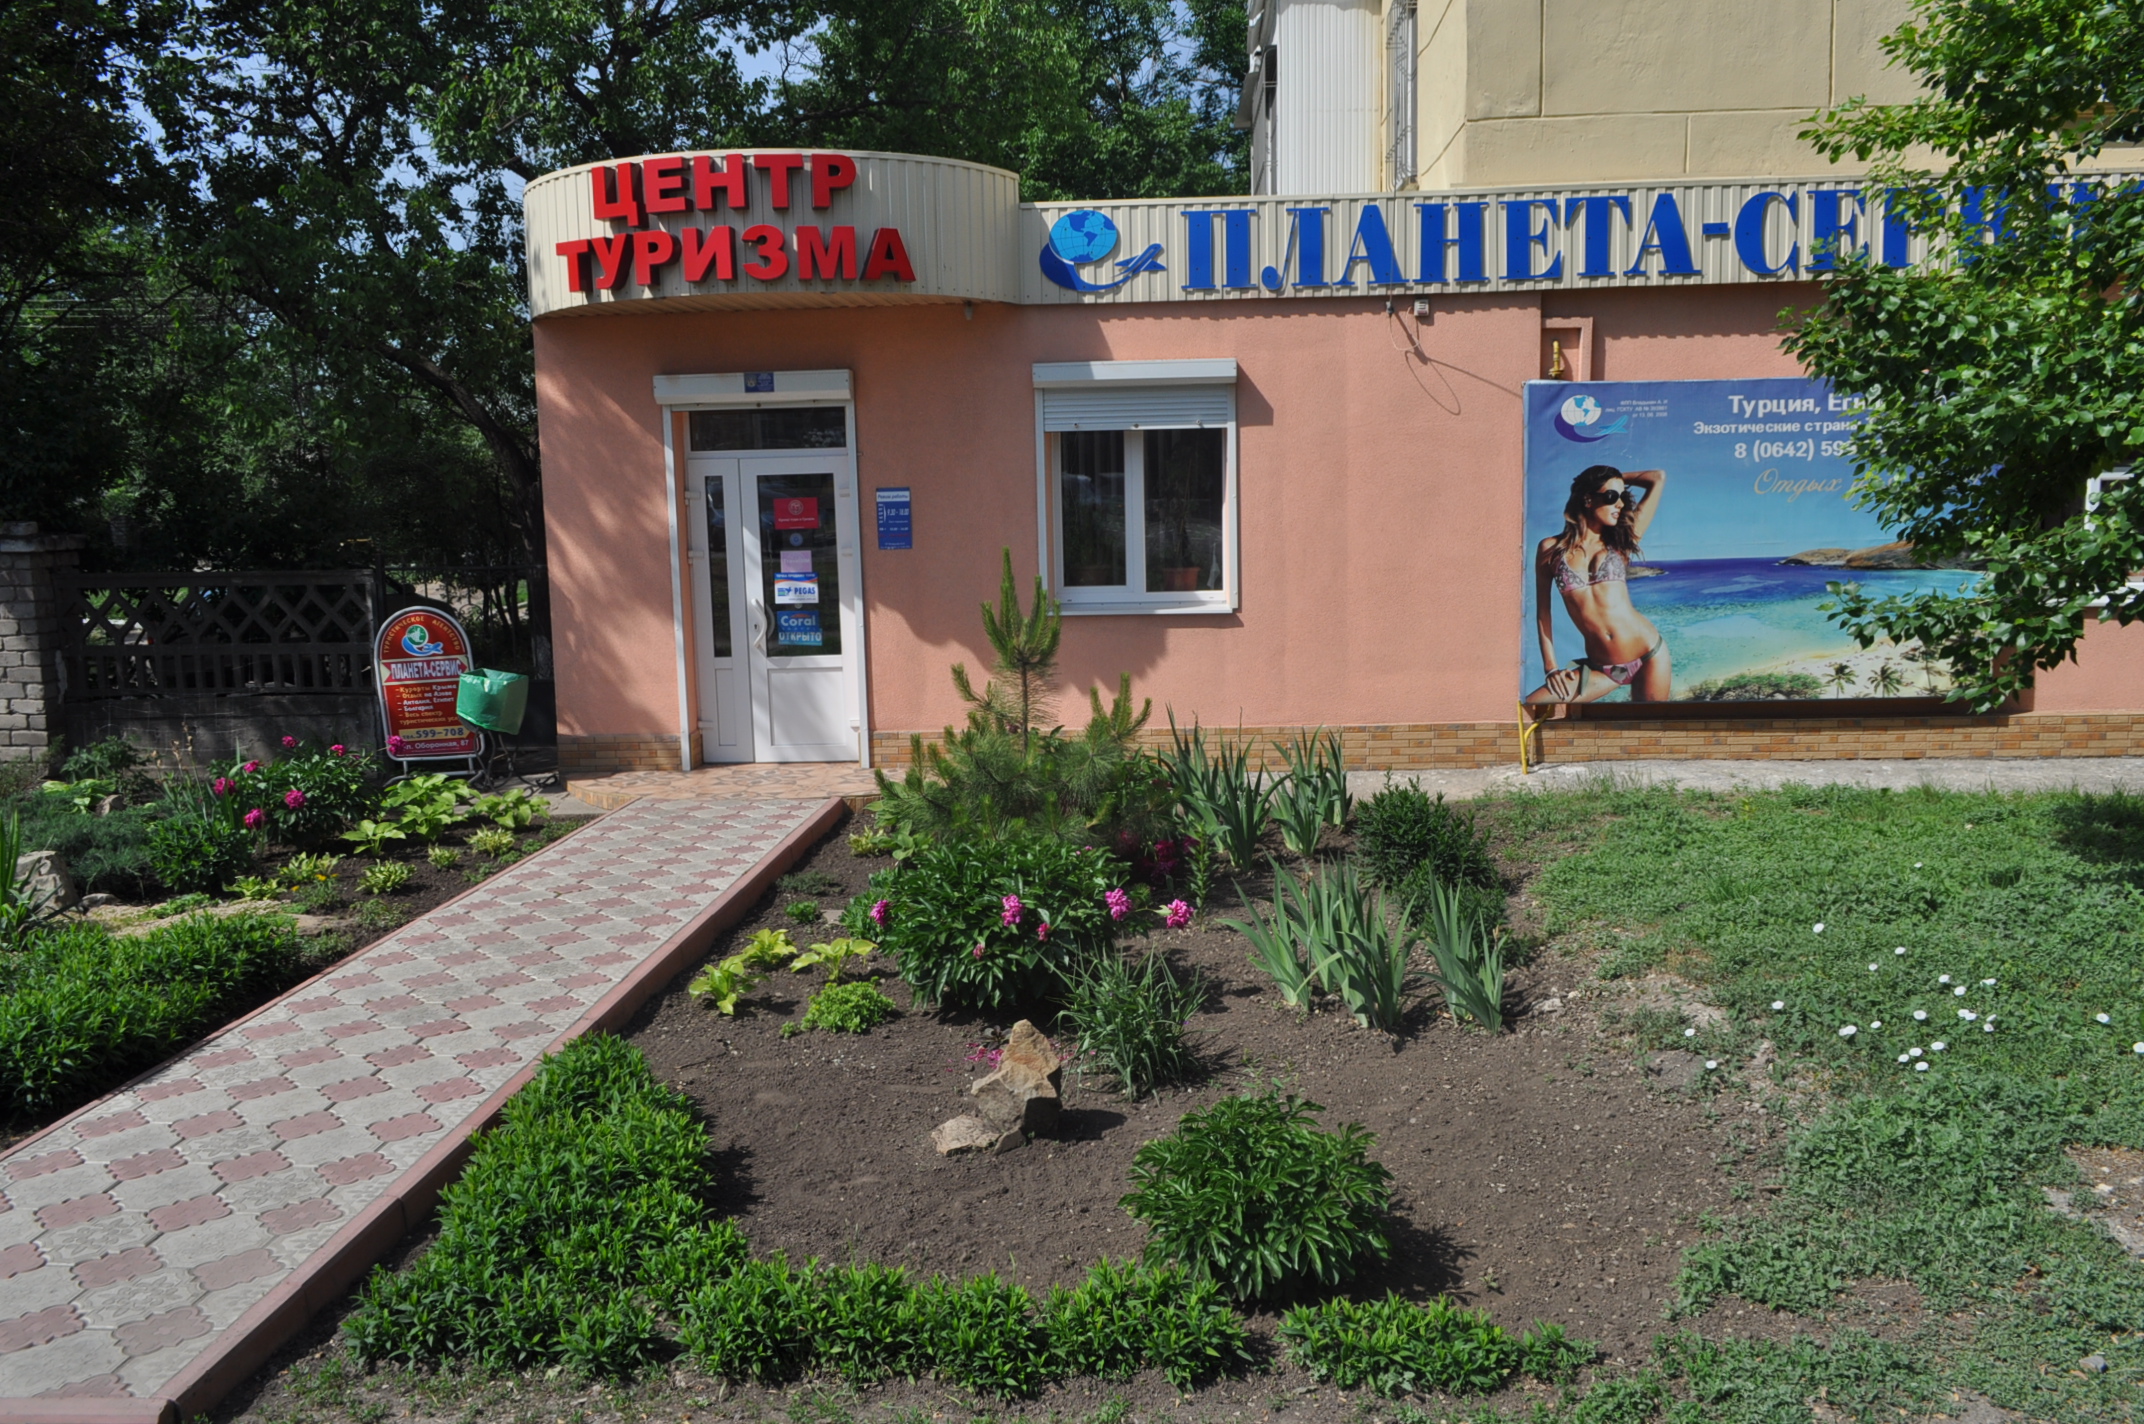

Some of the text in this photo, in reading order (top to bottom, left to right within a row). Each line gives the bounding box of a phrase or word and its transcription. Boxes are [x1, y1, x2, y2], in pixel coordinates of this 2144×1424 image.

[591, 153, 858, 228] ЦЕНТР
[555, 224, 917, 294] ТУРИЗМА
[1728, 394, 1821, 418] Турция,
[1693, 421, 1800, 434] Экзотические
[1734, 443, 1747, 458] 8
[1753, 439, 1815, 462] (0642)
[1753, 467, 1843, 503] Отдых
[794, 586, 816, 595] PEGAS
[781, 614, 816, 627] Coral
[383, 615, 460, 654] ТУРИСТИЧЕСКОЕ АГЕНТСТВО
[778, 631, 822, 642] ОТКРЫТО
[390, 660, 462, 680] ПЛАНЕТА-СЕРВИС
[400, 686, 431, 694] Курорты
[415, 727, 464, 739] 599-708
